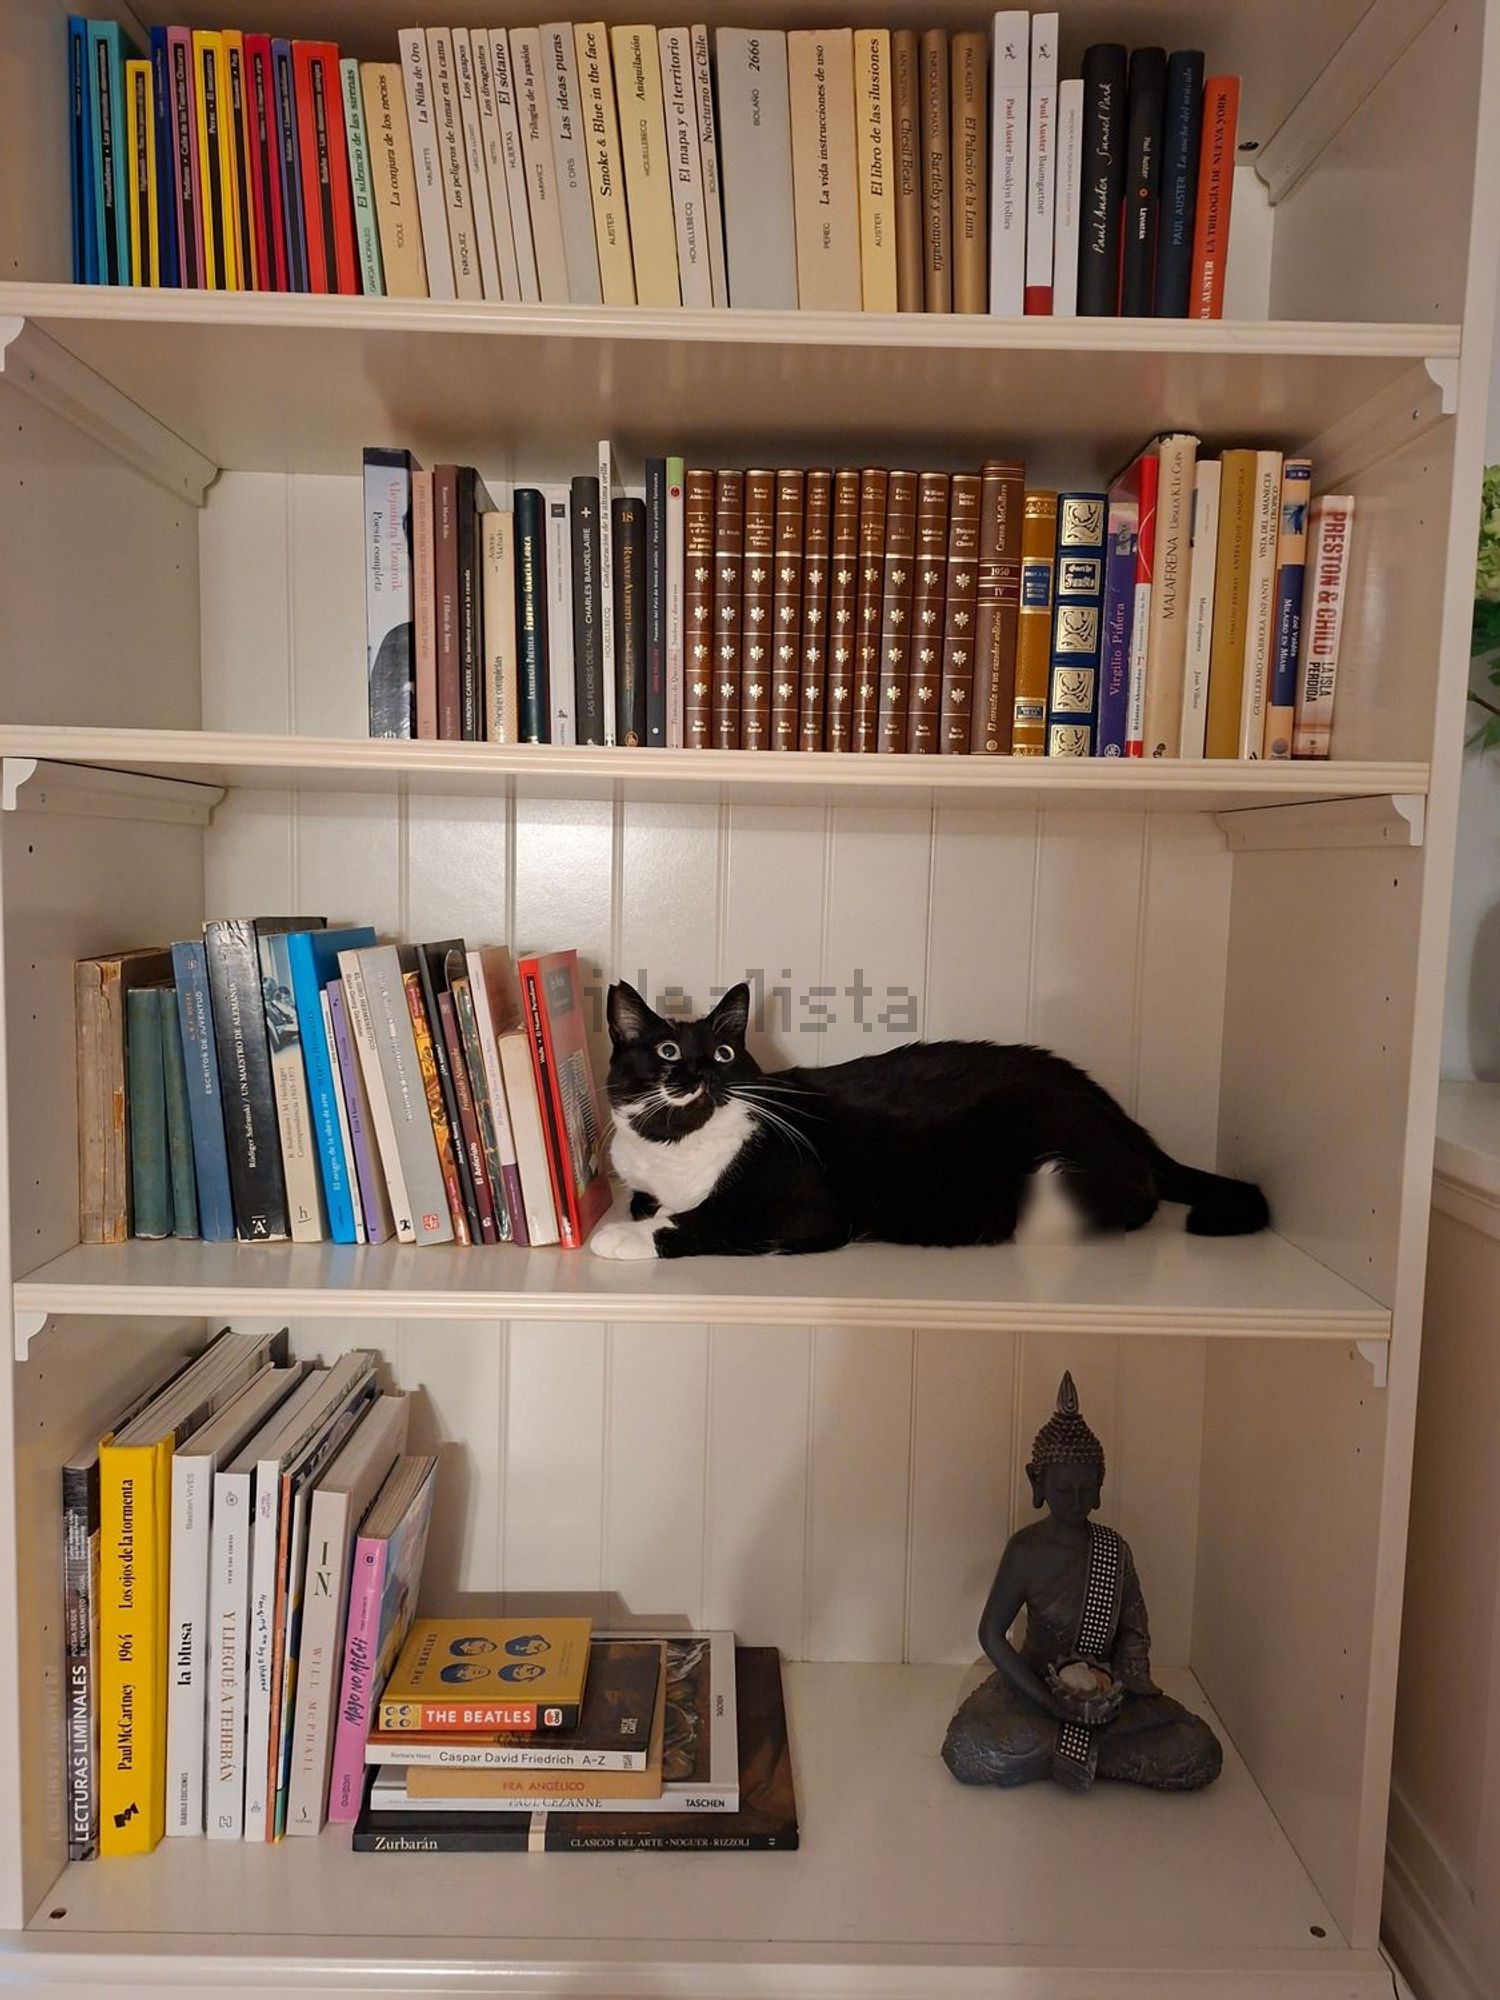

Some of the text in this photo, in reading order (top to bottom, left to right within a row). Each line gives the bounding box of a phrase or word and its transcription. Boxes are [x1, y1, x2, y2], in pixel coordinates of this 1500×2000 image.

[494, 43, 511, 105] El sótano
[585, 33, 597, 59] face
[588, 64, 600, 83] the
[631, 35, 646, 101] Aniquilación
[748, 40, 760, 72] 2666
[410, 43, 428, 123] La Niña de Oro
[552, 34, 572, 140] Las ideas puras
[591, 87, 602, 99] in
[668, 38, 691, 182] El mapa y el territorio
[695, 35, 714, 143] Nocturno de Chile
[346, 70, 368, 208] El silencio de las sirenas
[377, 76, 401, 206] La conjura de los necios
[436, 40, 463, 208] Los peligros de fumar en la cama
[593, 104, 606, 133] Blue
[815, 45, 830, 205] La vida instrucciones de uso
[867, 39, 882, 196] El libro de las ilusiones
[901, 119, 913, 156] Chesil
[598, 151, 612, 196] Smoke
[901, 161, 914, 195] Beach
[964, 117, 977, 238] El Palacio de la Luna
[1003, 99, 1014, 230] Paul Auster Brooklyn Follies
[1092, 83, 1113, 253] Paul Auster Sunset Park
[1200, 94, 1227, 319] UL AUSTER LA TRILOGÍA DE NUEVA YORK
[996, 484, 1008, 551] Carson McCullers
[1259, 473, 1271, 558] VISTA DEL AMANECER
[1162, 537, 1178, 619] MALAFRENA
[1312, 512, 1347, 654] PRESTON & CHILD
[582, 528, 594, 716] LAS FLORES DEL MAL CHARLES BAUDELAIRE
[1110, 603, 1125, 695] Virgilio Piñera
[1253, 577, 1269, 715] GUILLERMO CABRERA INFANTE
[494, 656, 505, 727] Poesías completas
[1305, 662, 1320, 702] PERDIDA
[1320, 662, 1335, 696] LA ISLA
[229, 982, 241, 1026] ALEMANIA
[196, 991, 212, 1094] ESCRITOS DE JUVENTUD
[233, 1027, 242, 1039] DE
[235, 1042, 247, 1081] MAESTRO
[238, 1083, 248, 1095] UN
[321, 1093, 329, 1107] arte
[322, 1109, 331, 1117] de
[243, 1104, 254, 1137] Safranski
[323, 1119, 333, 1136] obra
[246, 1139, 256, 1167] Rüdiger
[327, 1147, 336, 1155] de
[329, 1157, 341, 1180] origen
[470, 1143, 483, 1185] El Anticristo
[333, 1183, 340, 1191] El
[118, 1480, 136, 1609] Los ojos de la tormenta
[118, 1634, 133, 1662] 1964
[177, 1622, 193, 1685] la blusa
[410, 1633, 438, 1685] THE BEATLES
[217, 1611, 236, 1783] Y LLEGUÉ A TEHERÁN
[302, 1647, 322, 1775] WILL McPHAIL
[426, 1710, 531, 1723] THE BEATLES
[71, 1665, 90, 1841] LECTURAS LIMINALES
[117, 1683, 136, 1770] Paul McCartney
[439, 1751, 483, 1765] Caspar
[485, 1751, 519, 1764] David
[522, 1751, 574, 1765] Friedrich
[502, 1779, 585, 1792] FRA ANGÉLICO
[685, 1799, 725, 1808] TASCHEN
[374, 1837, 438, 1851] Zurbarán
